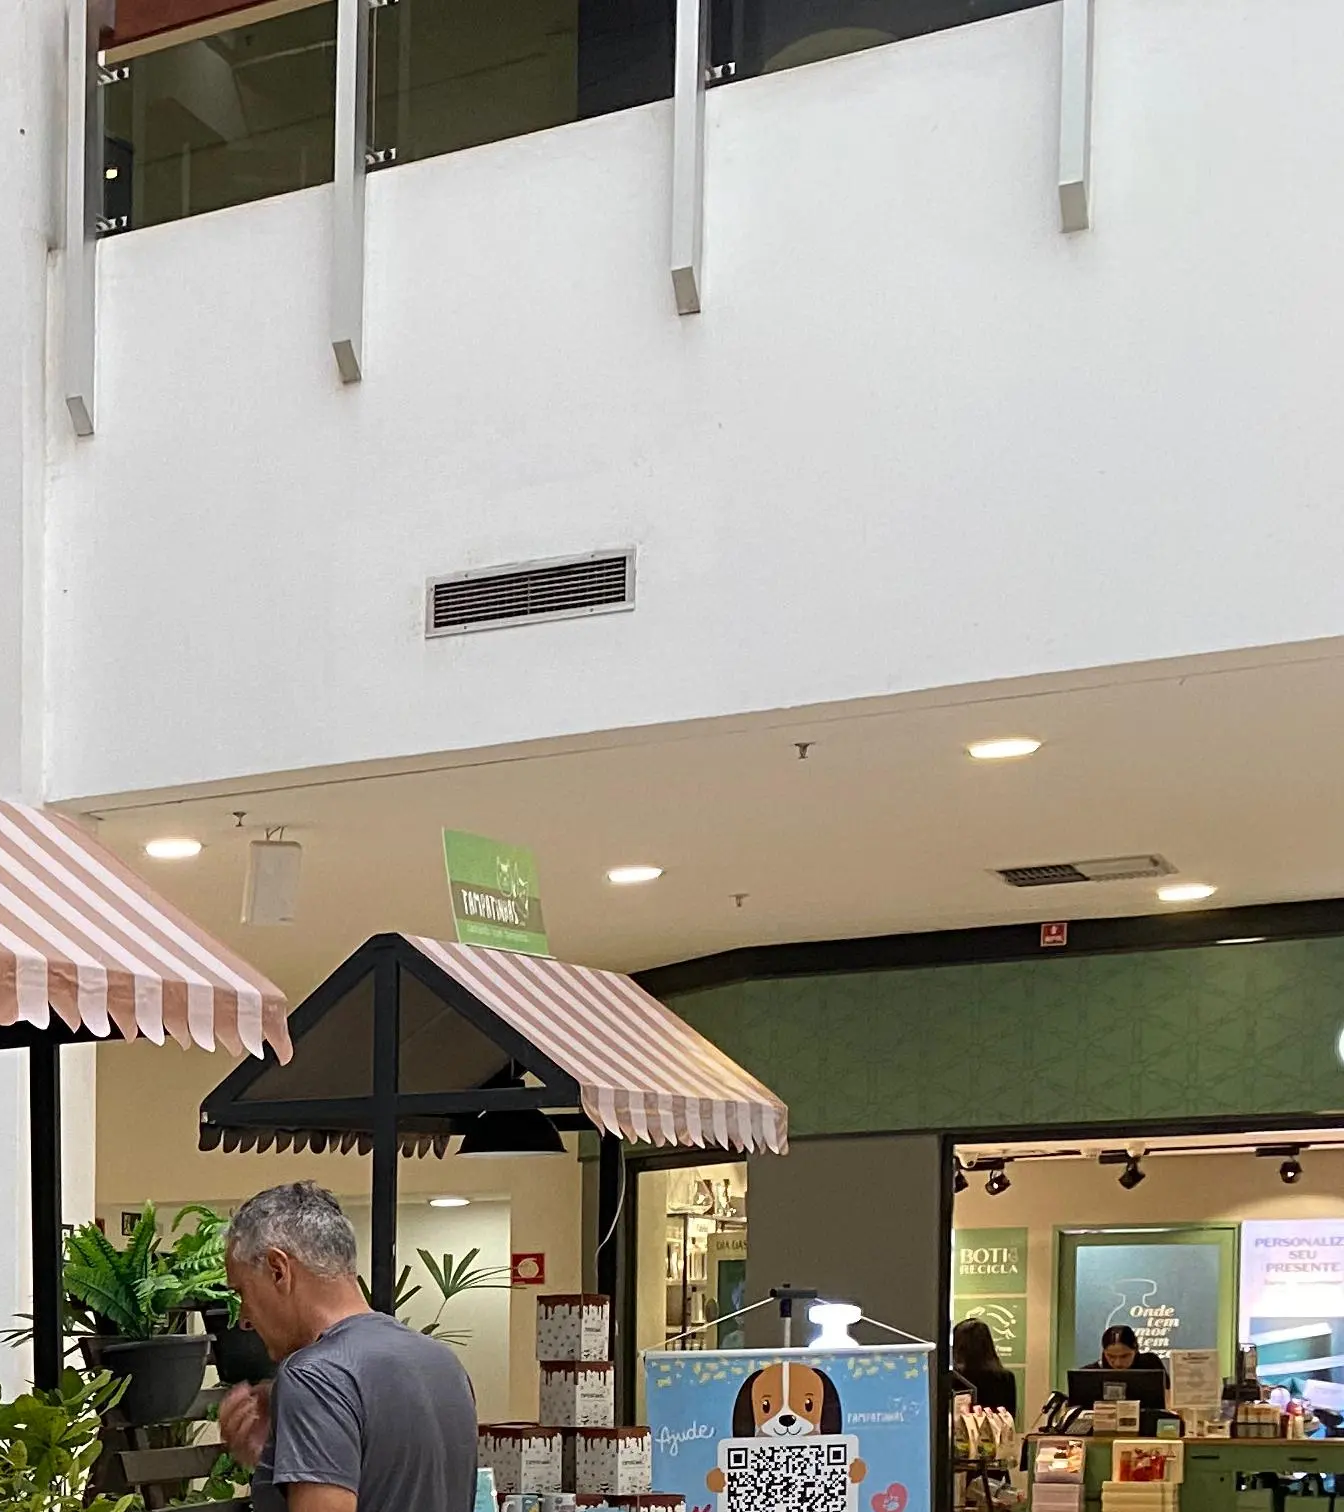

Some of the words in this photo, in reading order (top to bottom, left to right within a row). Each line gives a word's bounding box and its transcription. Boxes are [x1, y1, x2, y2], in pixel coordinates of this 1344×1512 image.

[1288, 1250, 1317, 1260] SEU
[960, 1264, 1018, 1274] RECICLA
[1266, 1262, 1341, 1272] PRESENTE
[1130, 1304, 1175, 1317] Onde
[1147, 1317, 1180, 1327] tem
[655, 1420, 715, 1456] Ajude
